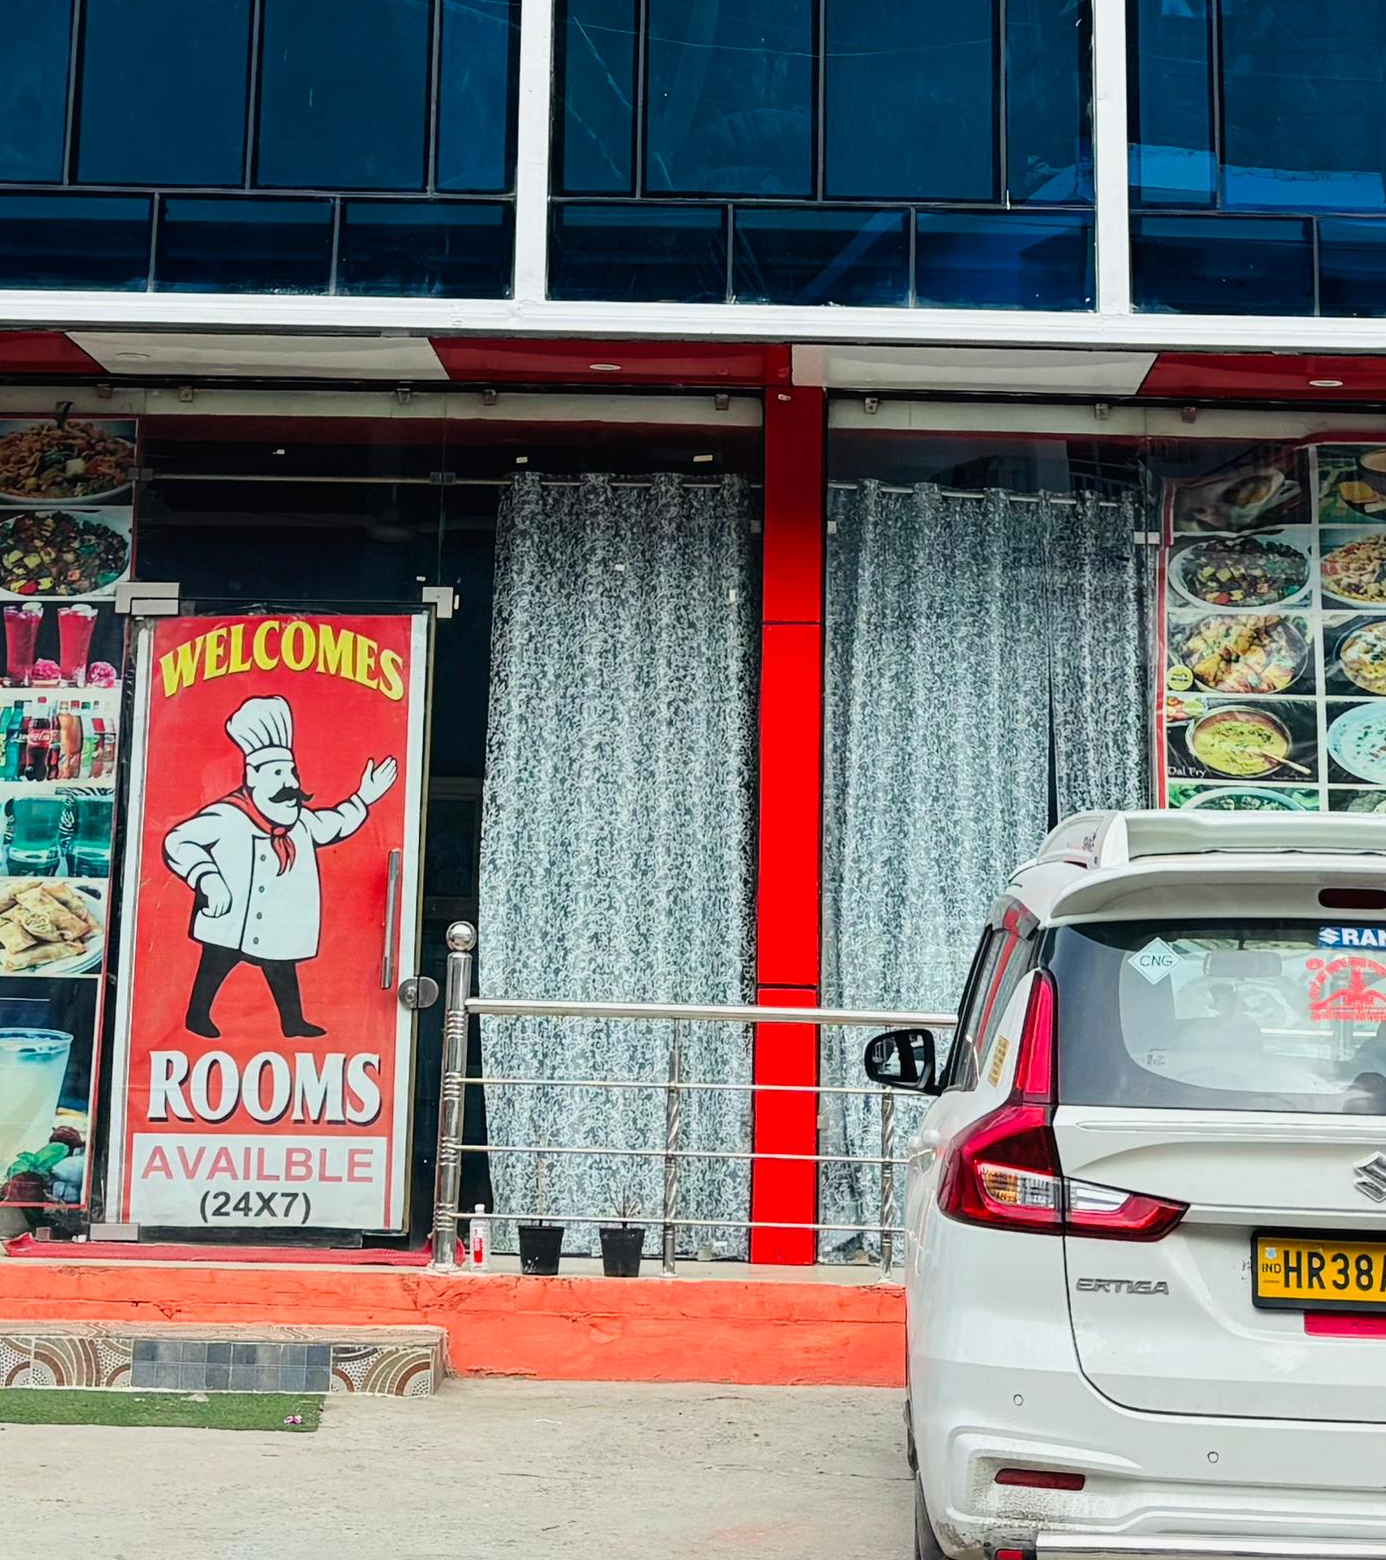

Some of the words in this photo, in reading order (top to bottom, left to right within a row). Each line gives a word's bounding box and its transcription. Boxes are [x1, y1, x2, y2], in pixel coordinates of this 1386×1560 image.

[158, 619, 406, 702] WELCOMES
[1167, 765, 1186, 776] Dal
[1187, 767, 1207, 778] Fry
[1139, 954, 1173, 967] CNG
[146, 1050, 382, 1127] ROOMS
[141, 1144, 375, 1184] AVAILBLE
[199, 1190, 312, 1225] (24X7)
[1261, 1262, 1282, 1274] IND
[1075, 1277, 1170, 1296] ERTIGA
